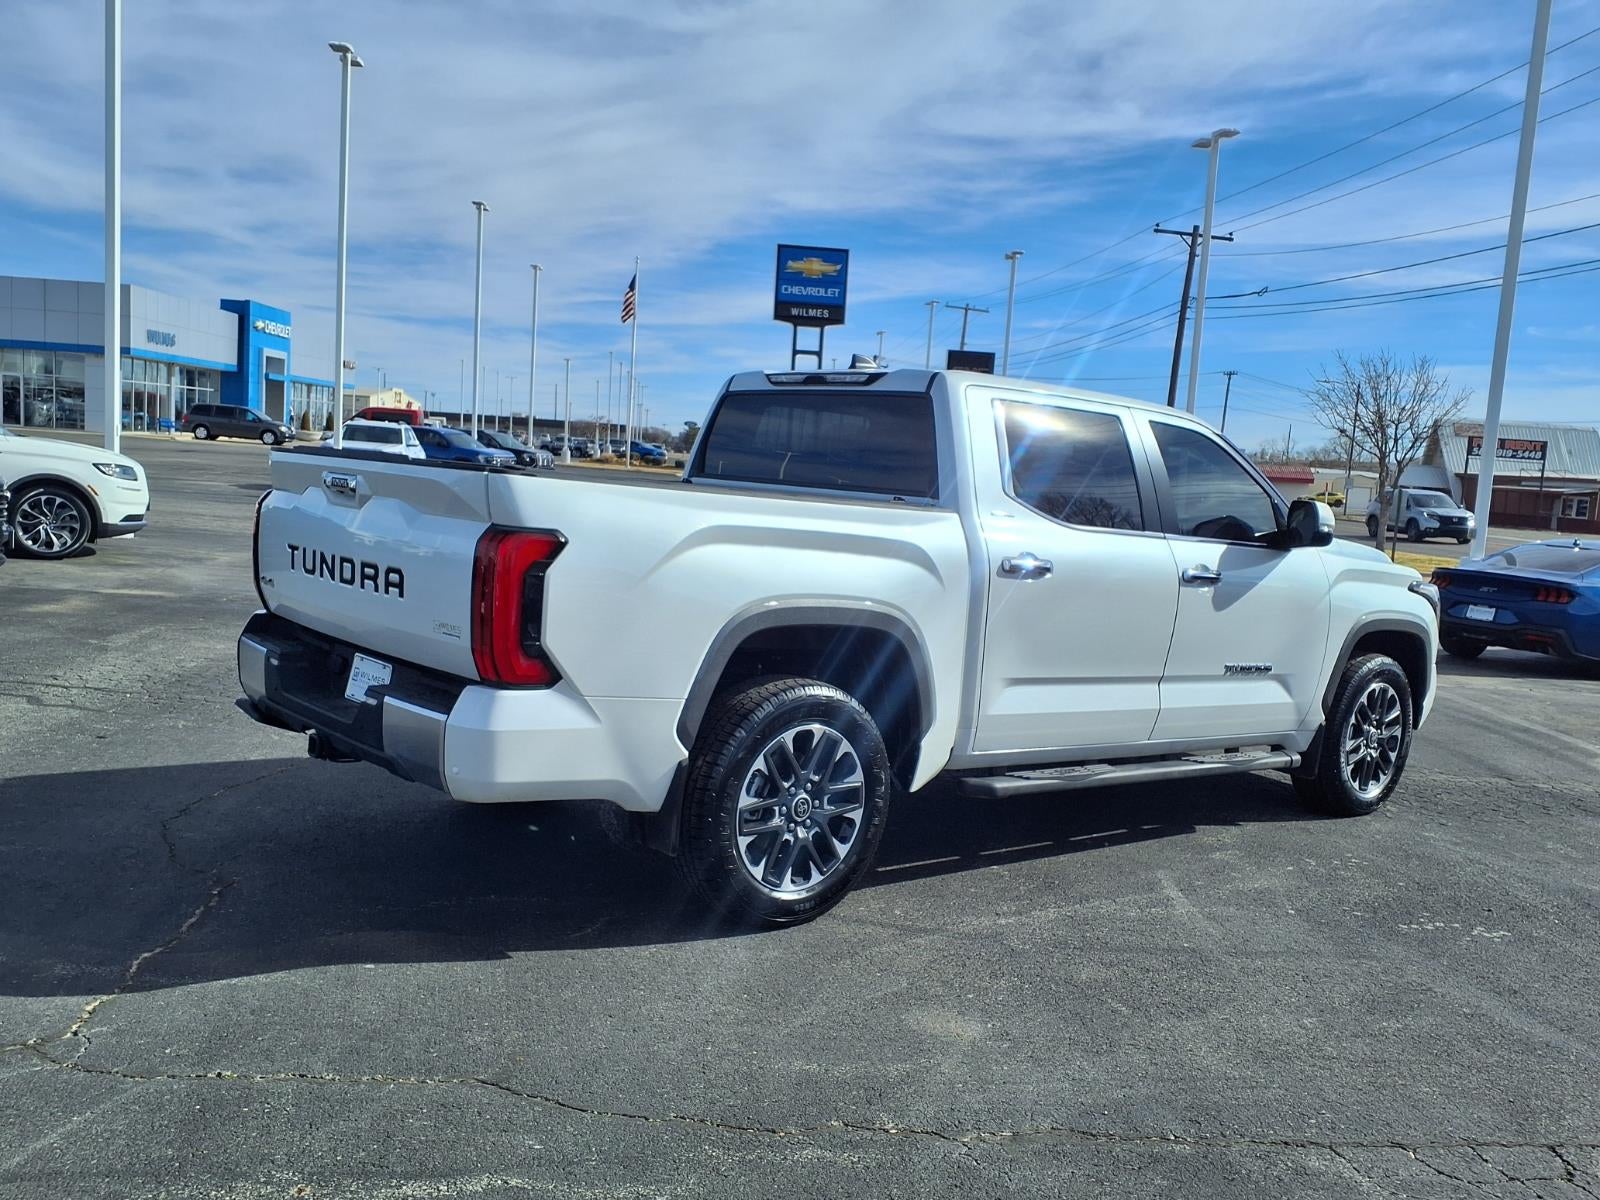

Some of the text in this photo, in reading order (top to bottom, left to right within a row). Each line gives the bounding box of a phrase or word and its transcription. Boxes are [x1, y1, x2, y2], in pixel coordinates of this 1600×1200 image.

[781, 285, 840, 297] CHEVROLET
[791, 307, 829, 318] WILMES
[265, 320, 291, 338] CHEVROLET
[1505, 440, 1544, 451] RENT
[286, 543, 405, 600] TUNDRA
